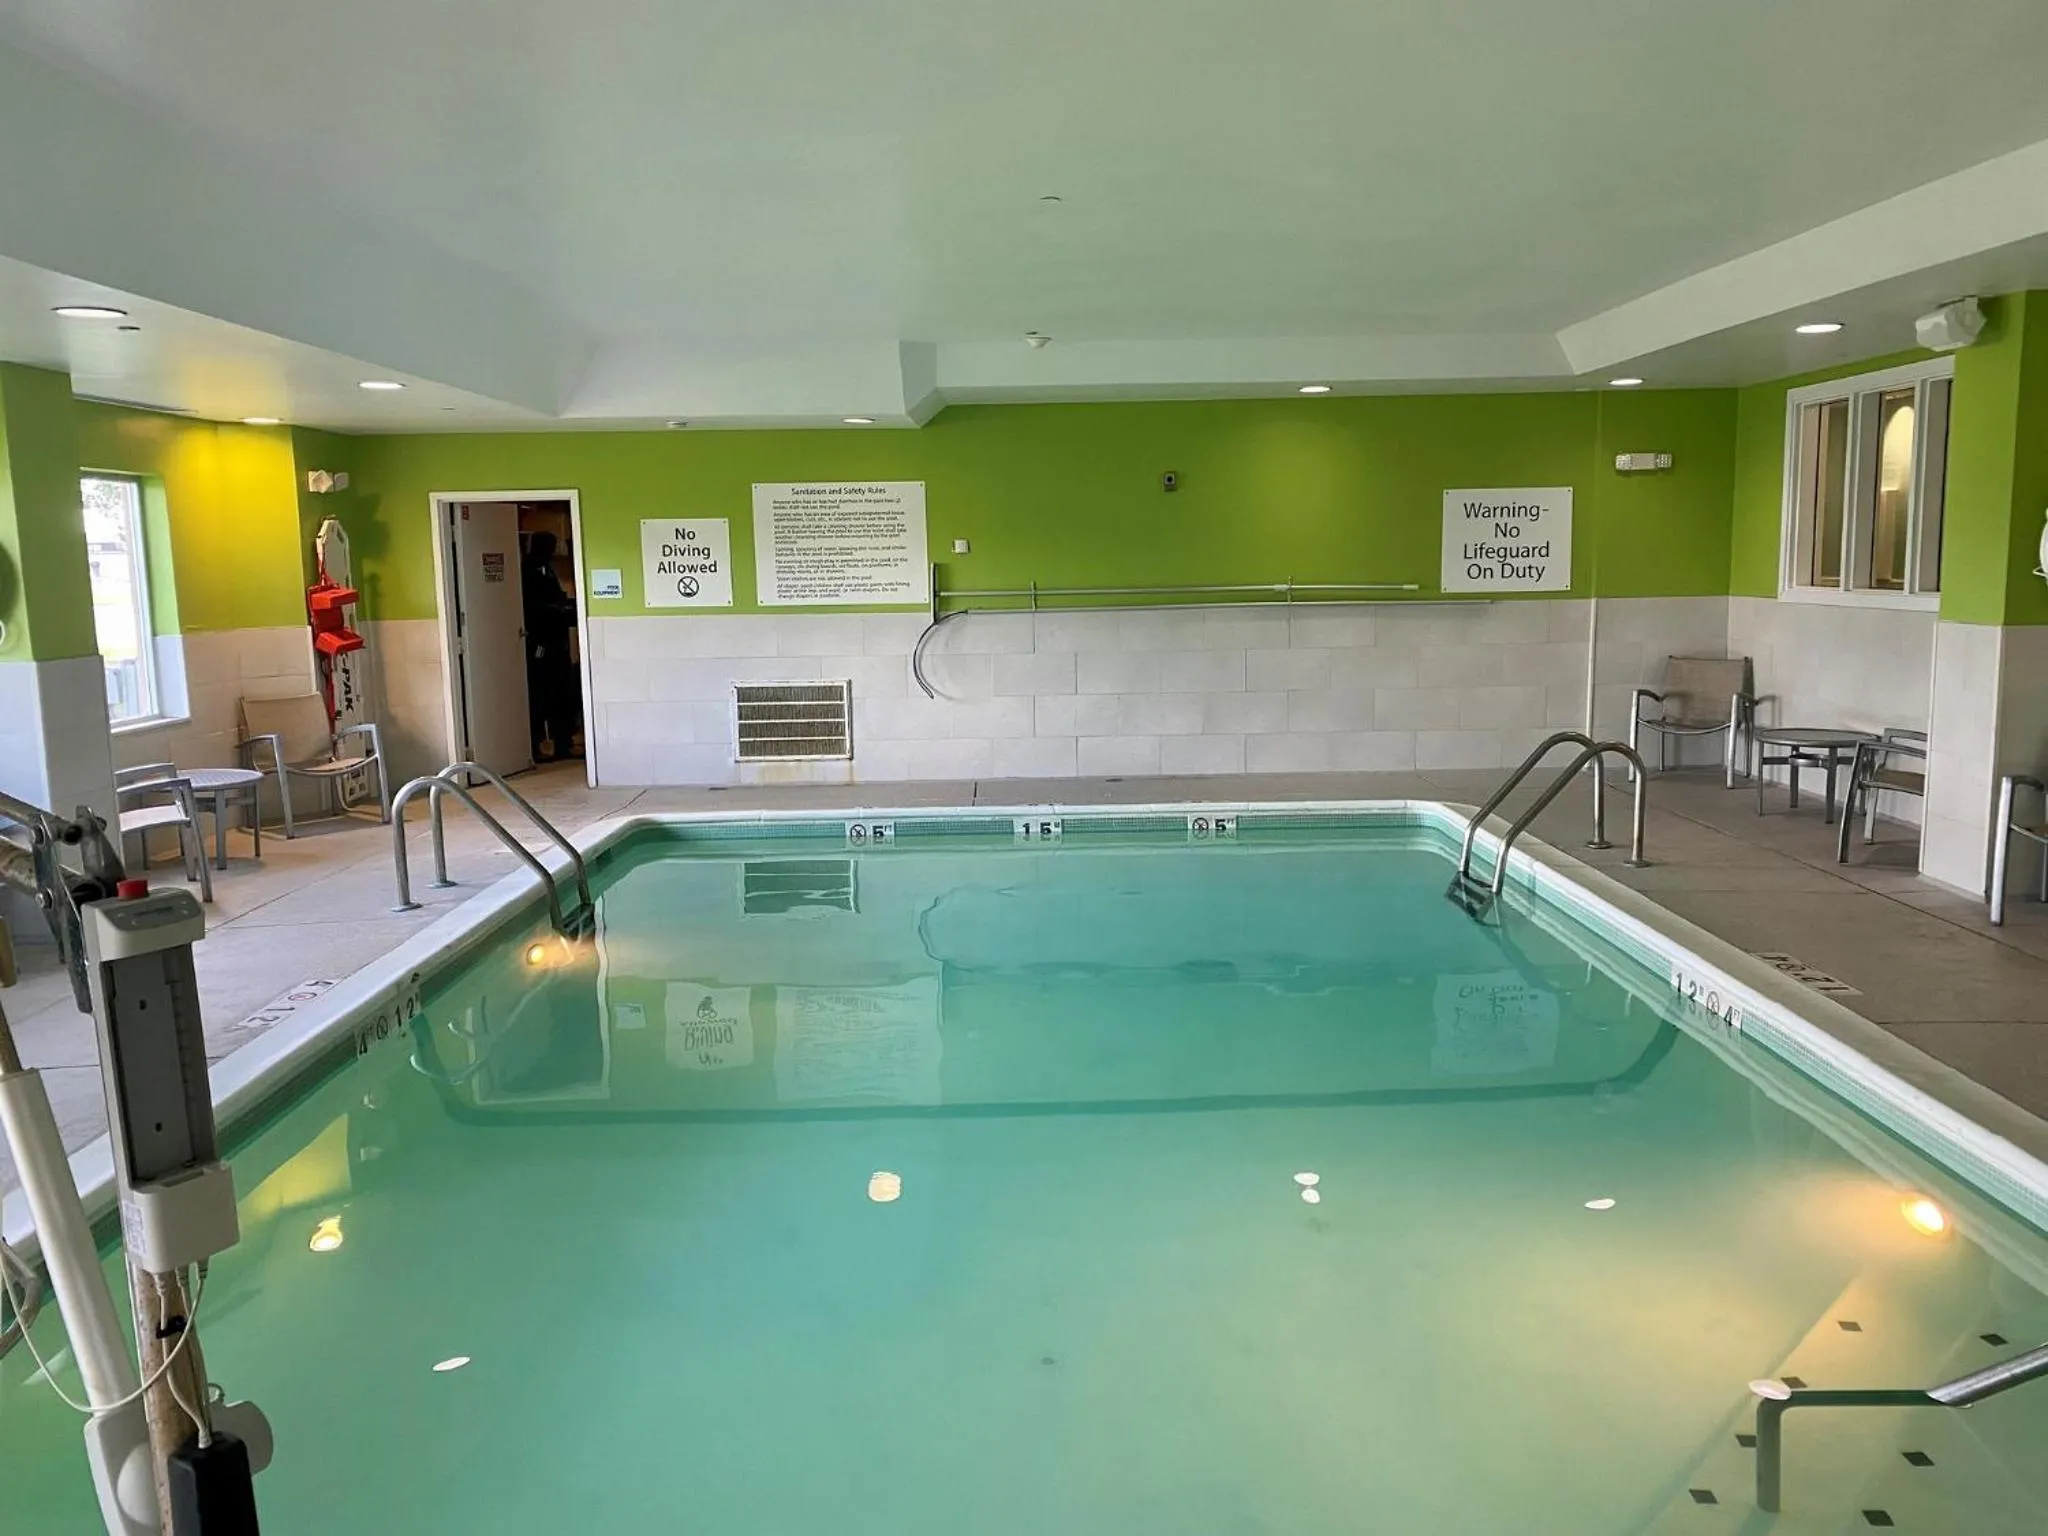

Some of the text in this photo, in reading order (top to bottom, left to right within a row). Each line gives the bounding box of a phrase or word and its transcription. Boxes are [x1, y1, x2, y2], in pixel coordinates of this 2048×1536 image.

[791, 487, 887, 497] Sanitation and Safety Rules
[675, 528, 696, 541] No
[1494, 522, 1521, 538] No
[662, 544, 711, 560] Diving
[1464, 540, 1550, 563] Lifeguard
[657, 560, 718, 574] Allowed
[1467, 562, 1546, 583] On Duty
